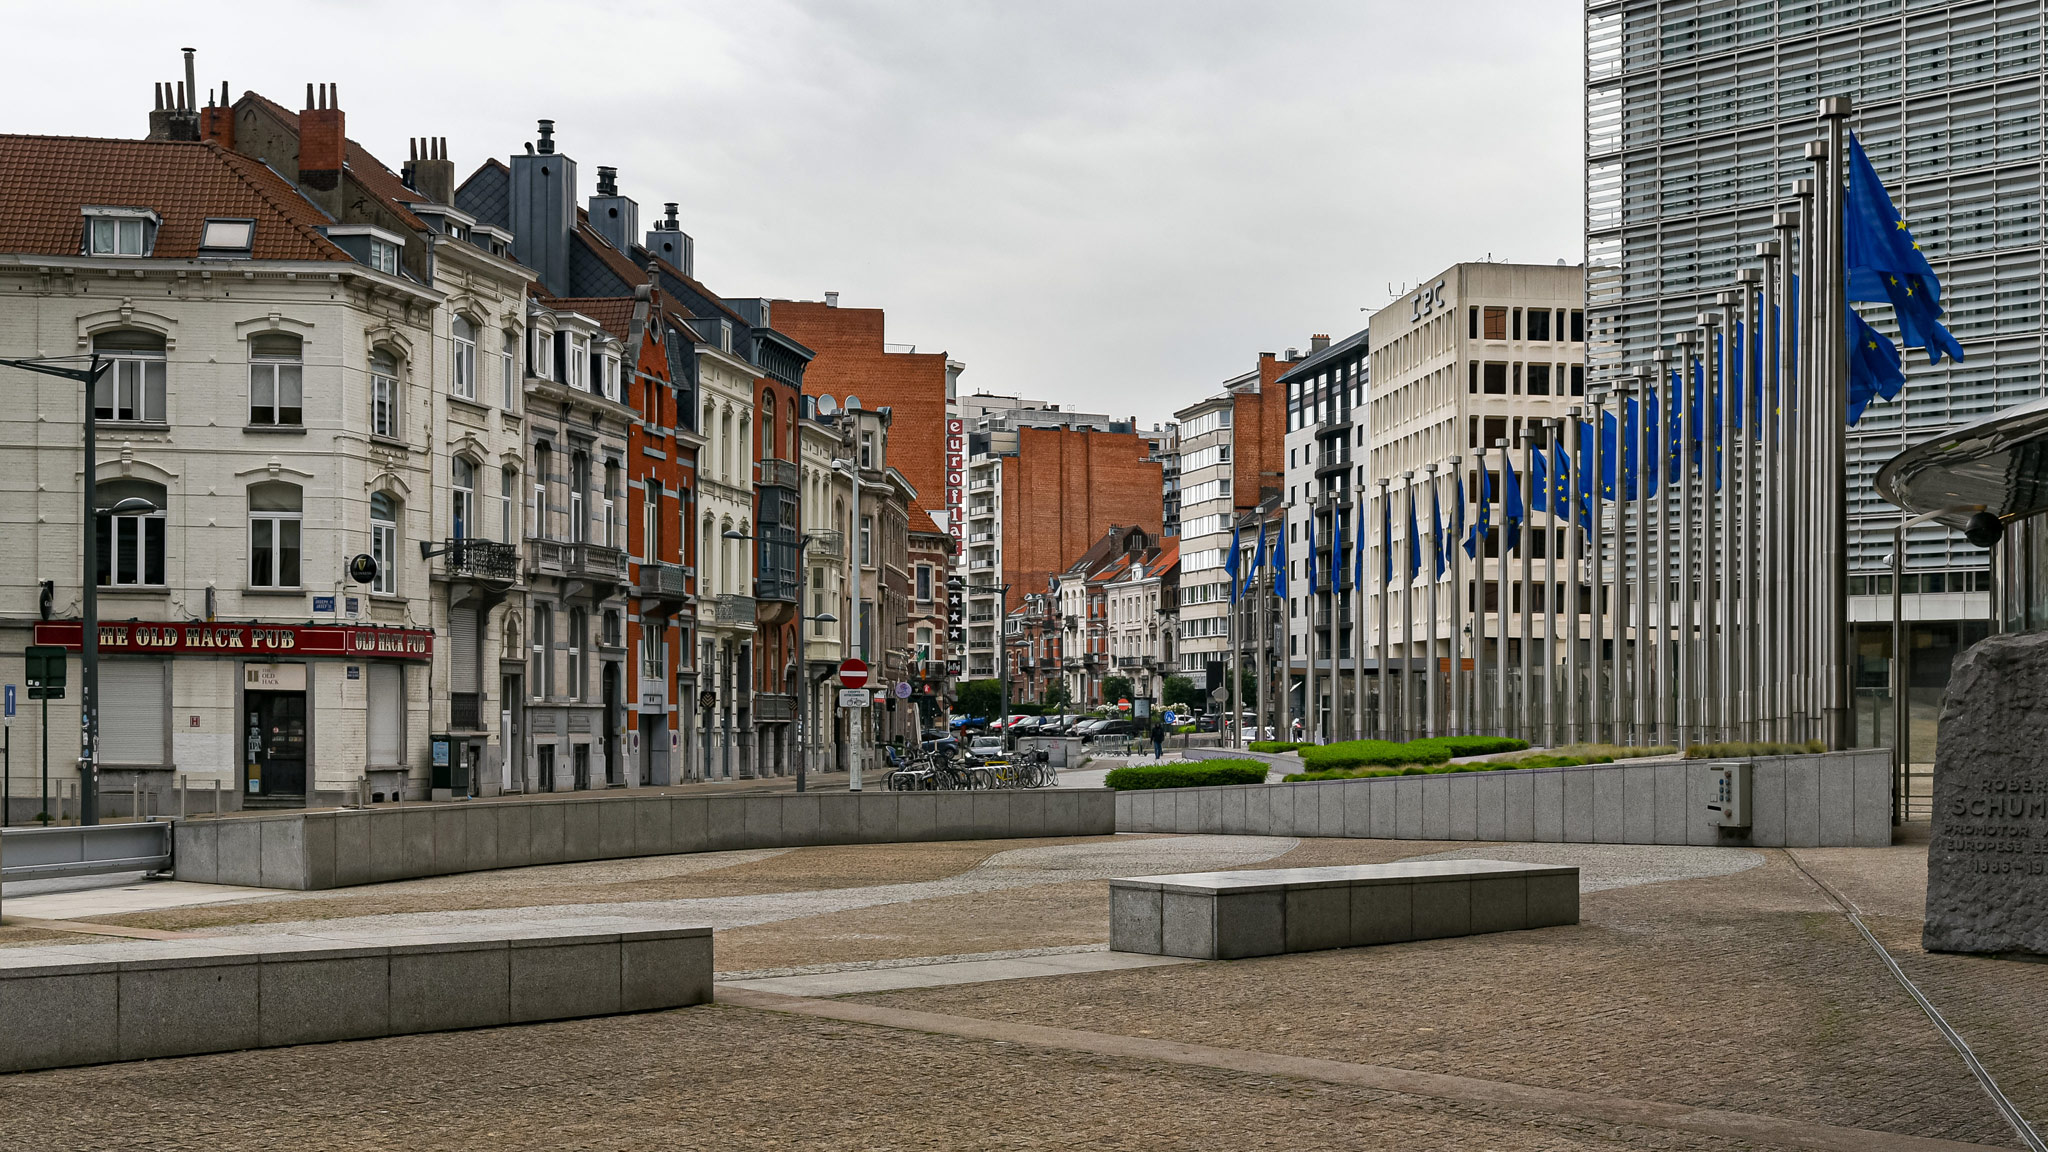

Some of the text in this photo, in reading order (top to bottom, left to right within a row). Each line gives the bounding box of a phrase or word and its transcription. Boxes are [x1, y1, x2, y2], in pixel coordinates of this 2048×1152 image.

[949, 421, 961, 556] eurofla
[98, 627, 295, 649] HE OLD HACK PUB
[356, 631, 425, 653] OLD HACK PUB
[1950, 798, 2047, 818] SCHUM
[1943, 824, 2029, 838] PROMOTOR
[1947, 840, 2023, 854] EUROPESE
